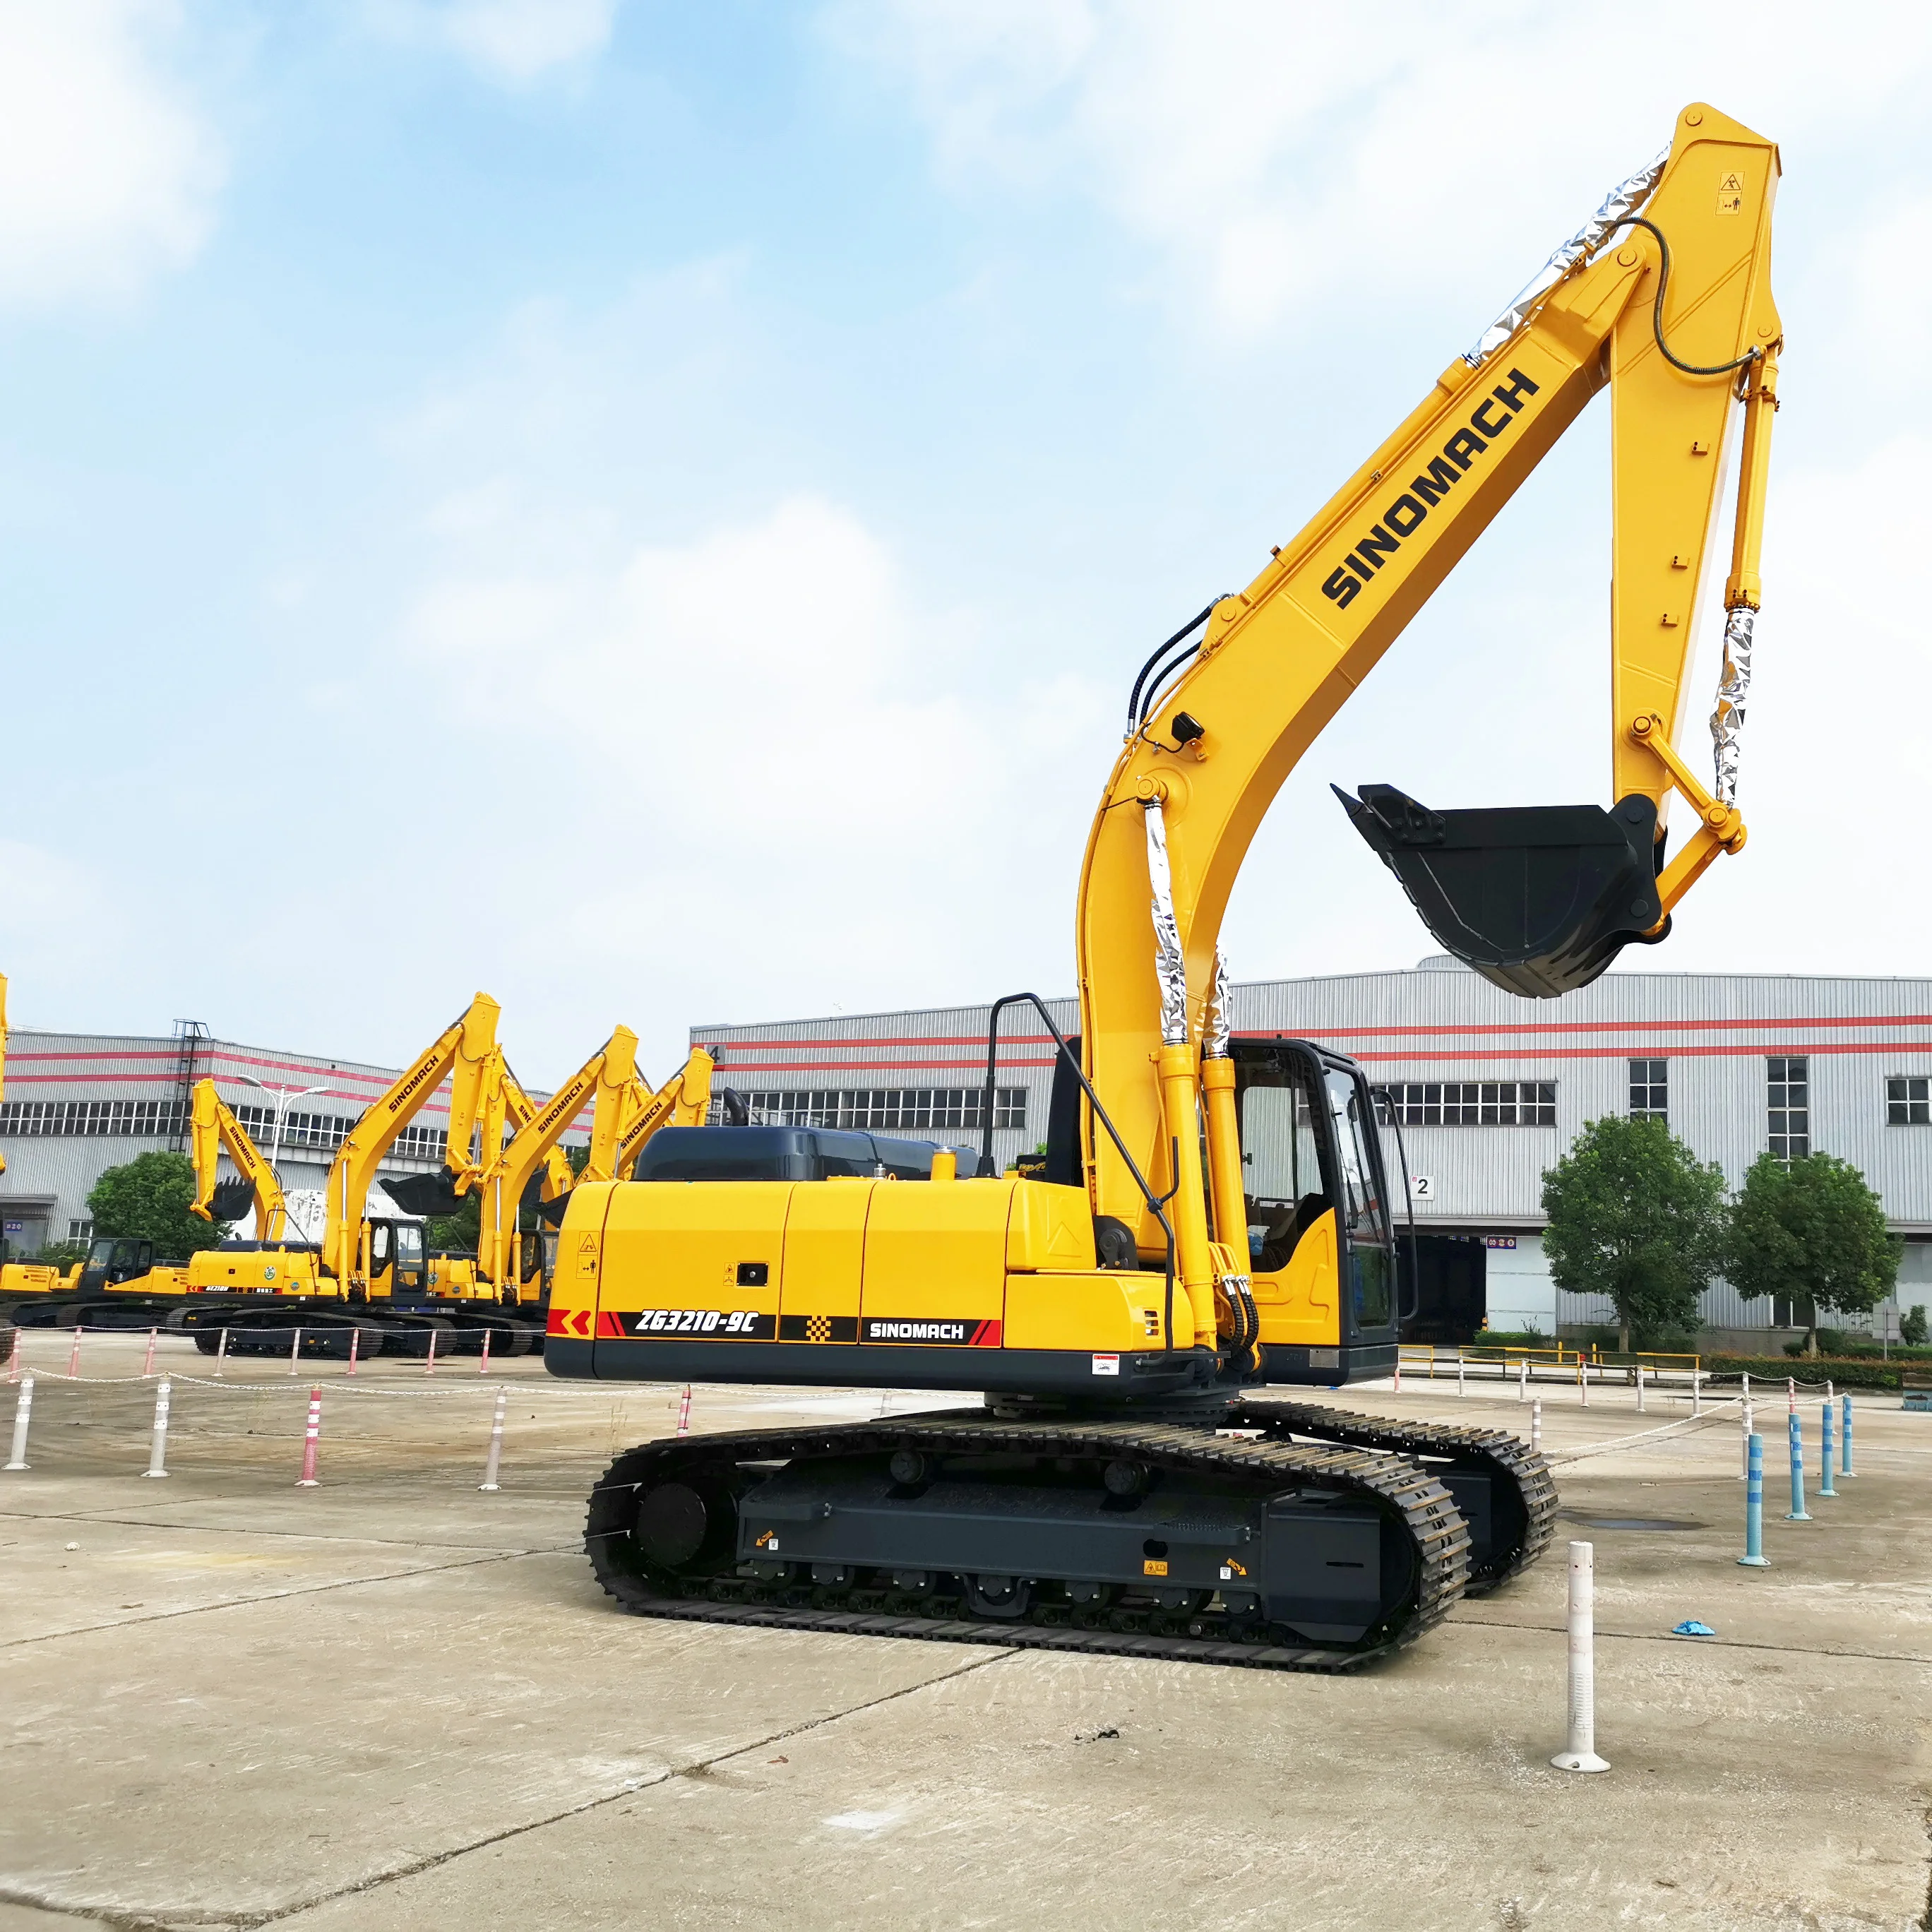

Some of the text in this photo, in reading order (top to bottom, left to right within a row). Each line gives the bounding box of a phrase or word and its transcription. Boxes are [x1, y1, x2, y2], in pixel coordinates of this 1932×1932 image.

[1321, 367, 1540, 610] SINOMACH
[709, 1046, 720, 1063] 4
[389, 1055, 439, 1113] SINOMACH
[538, 1082, 583, 1134] SINOMACH
[620, 1101, 663, 1150] SINOMACH
[229, 1126, 256, 1169] SINOMACH
[1417, 1179, 1428, 1194] 2
[634, 1309, 760, 1332] ZG3210-9C
[869, 1323, 965, 1340] SINOMACH
